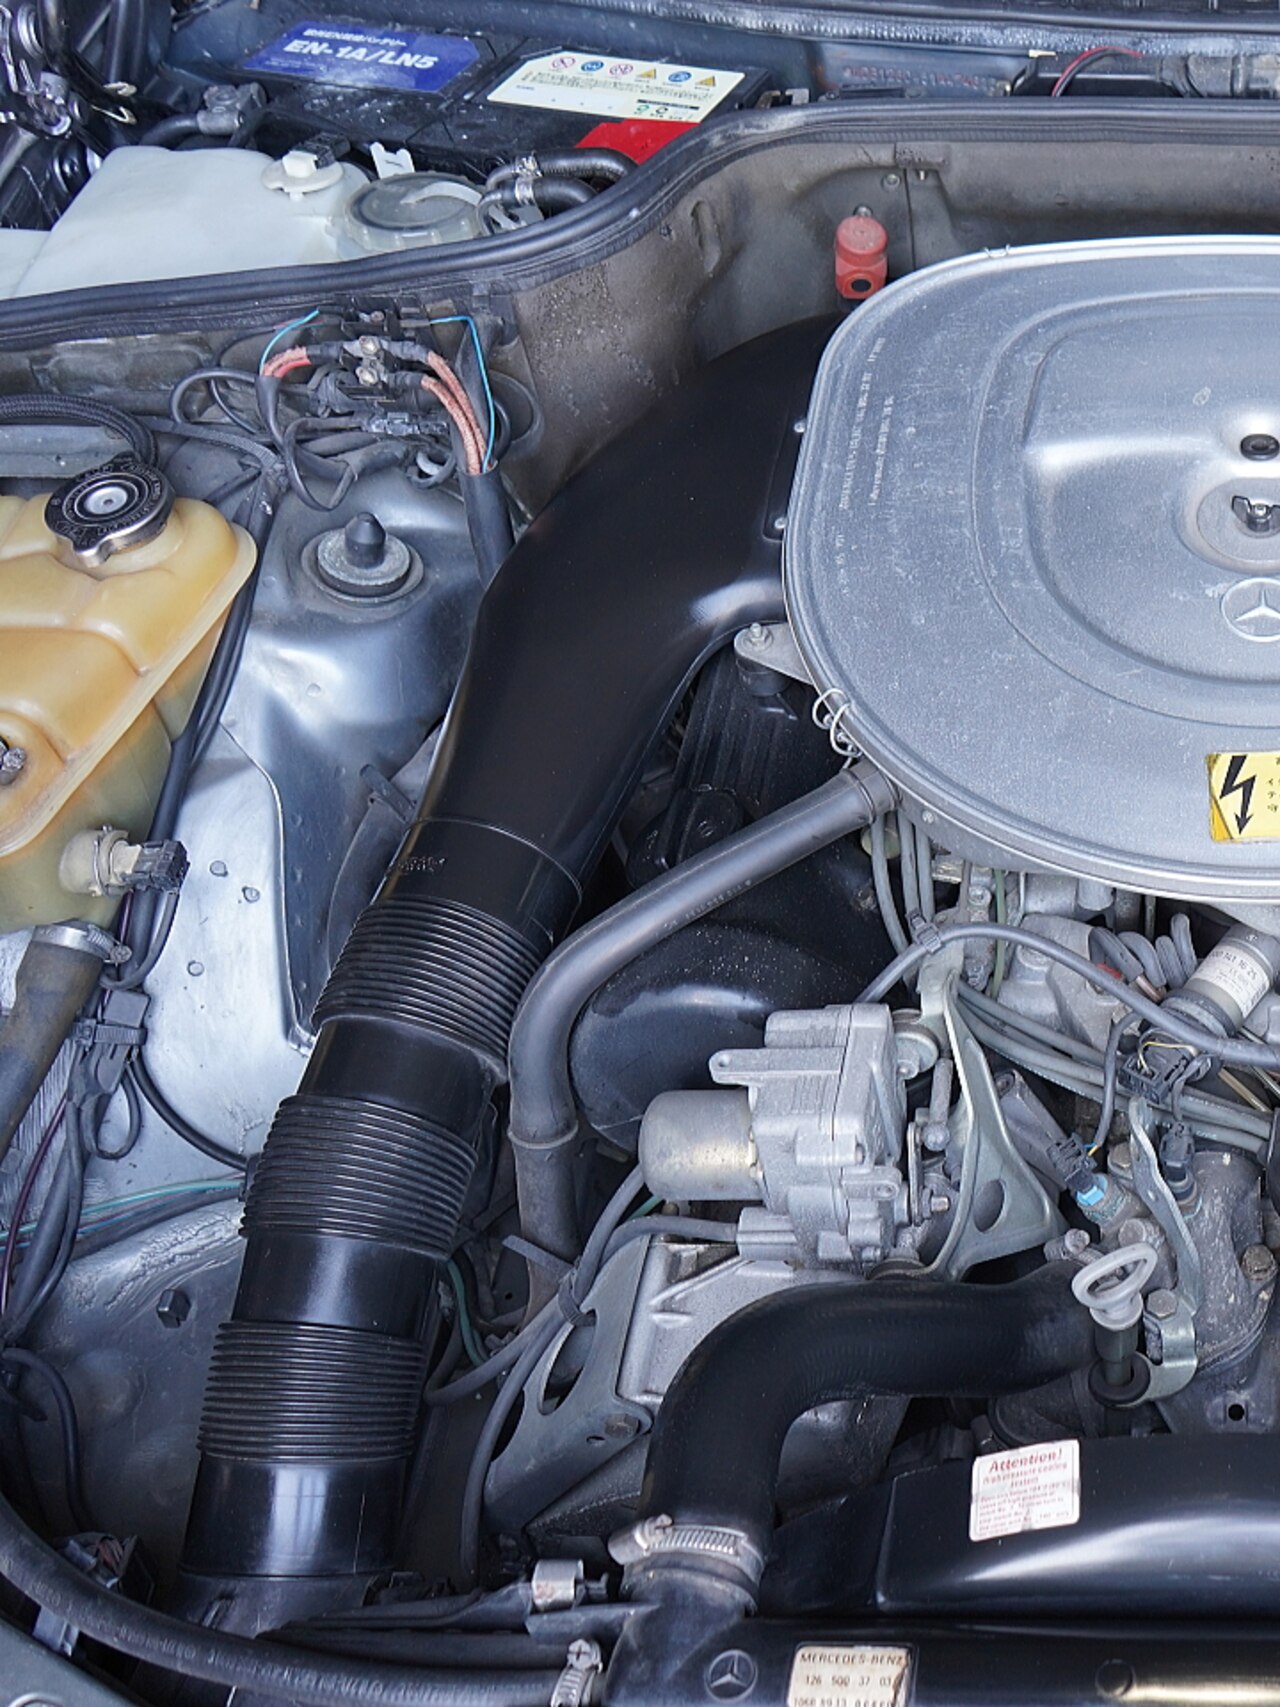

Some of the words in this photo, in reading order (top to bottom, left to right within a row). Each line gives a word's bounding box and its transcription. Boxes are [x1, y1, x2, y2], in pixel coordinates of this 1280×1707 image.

[283, 38, 440, 69] EN-1A/LN5
[989, 1447, 1063, 1474] Attention!
[800, 1652, 903, 1665] MERCEDES-BENZ
